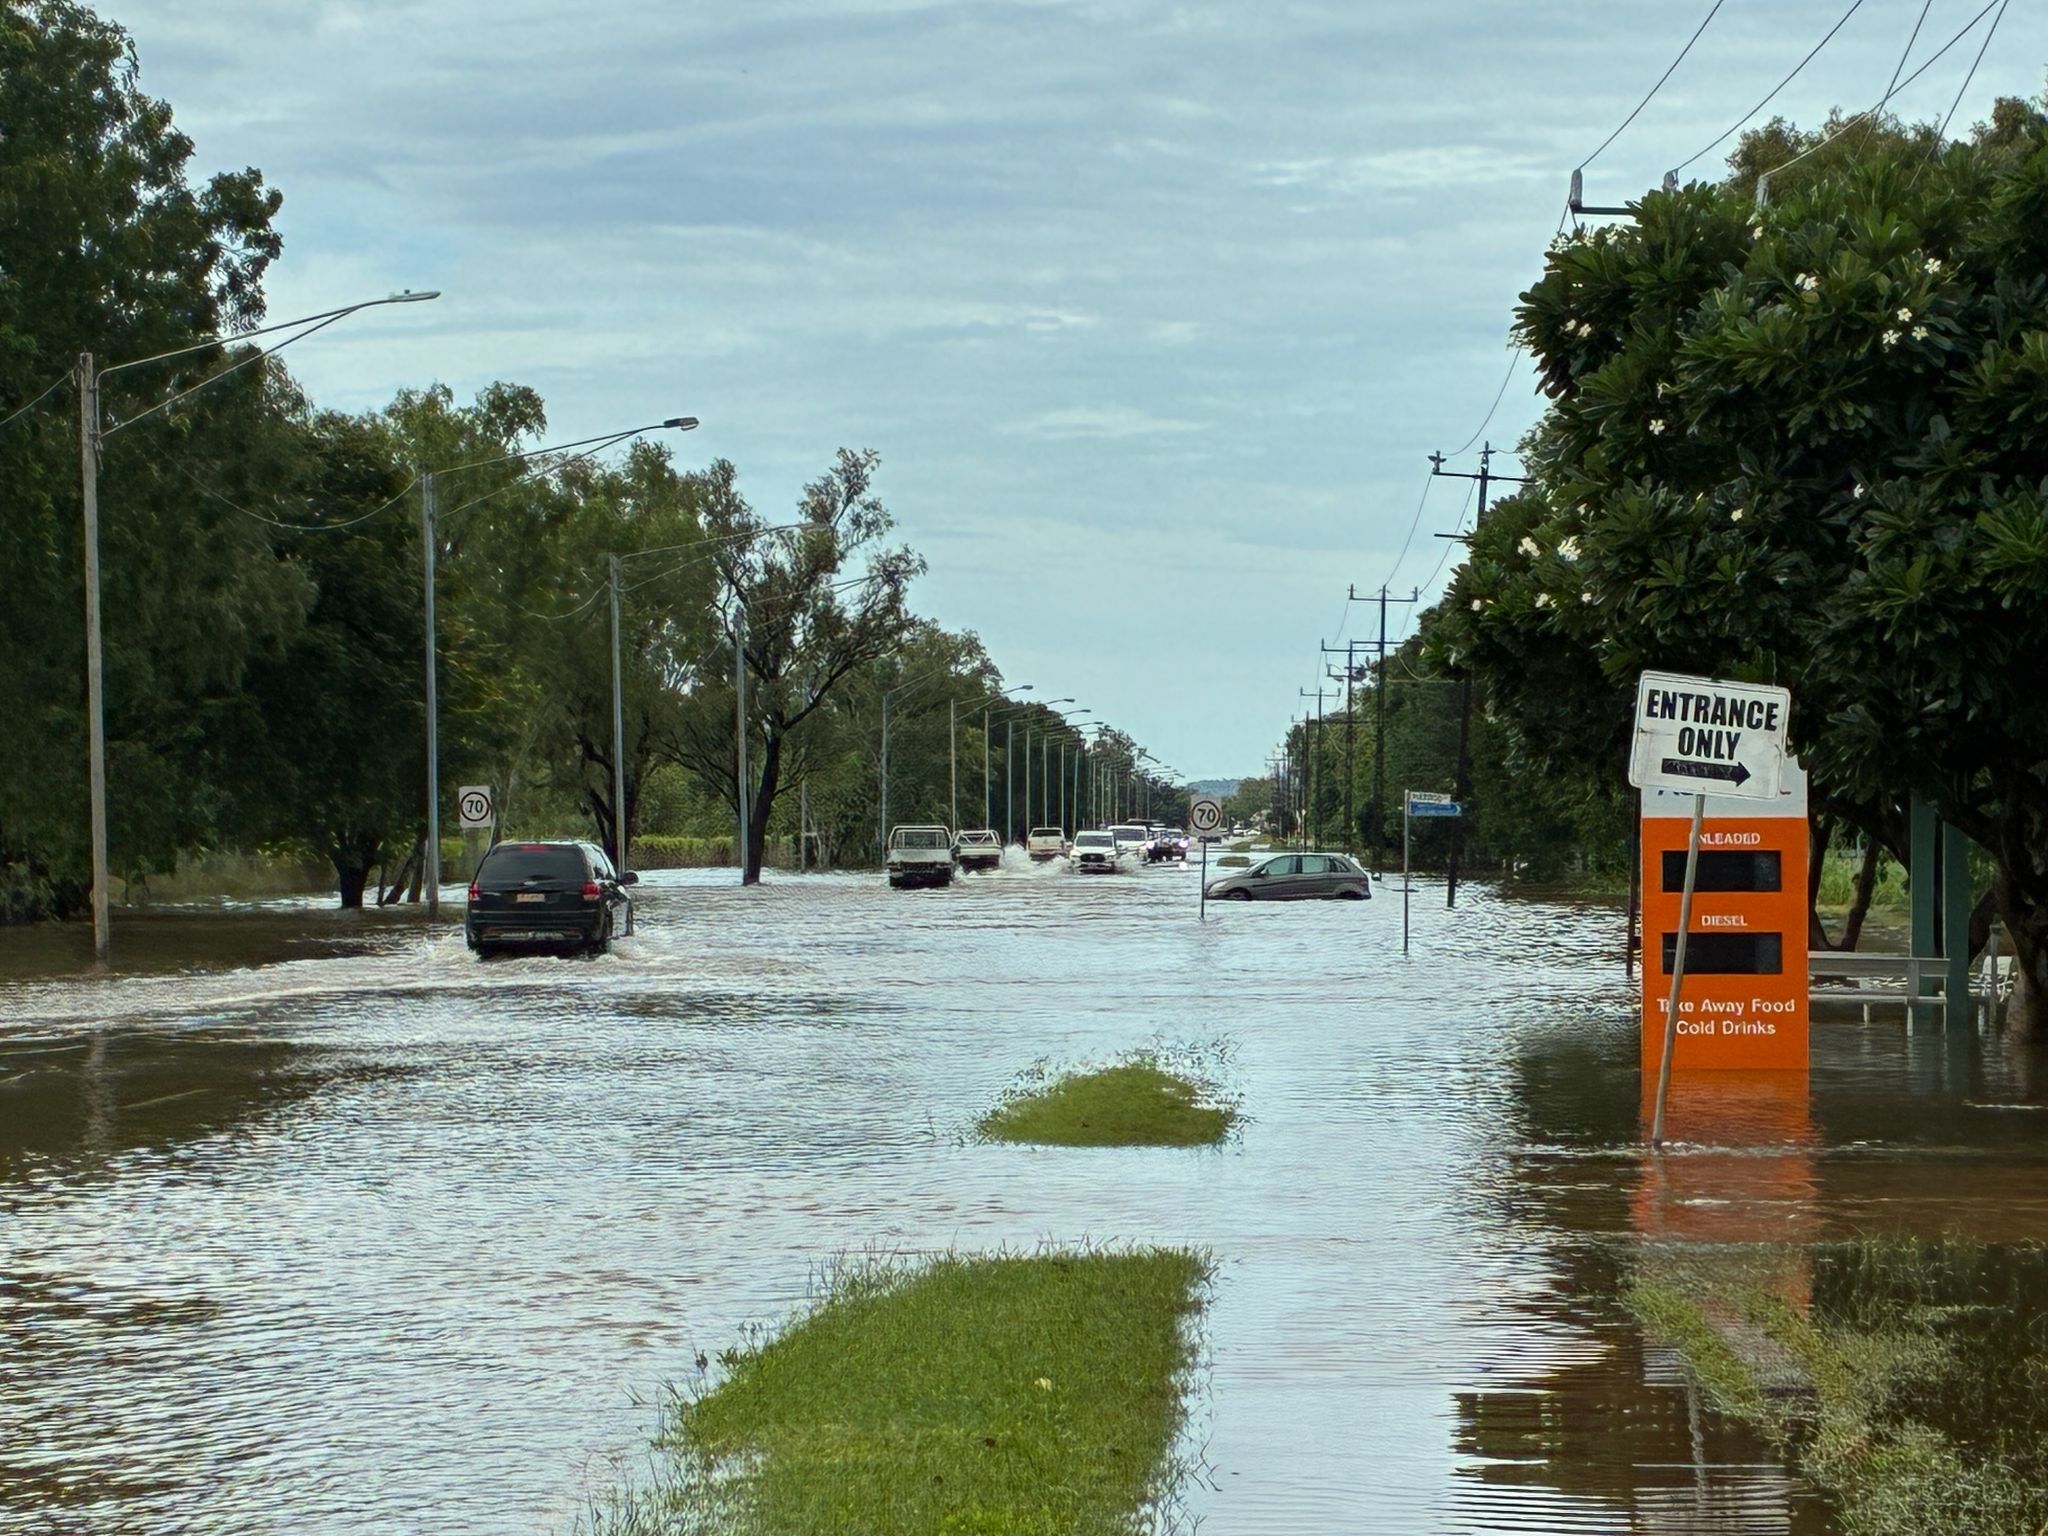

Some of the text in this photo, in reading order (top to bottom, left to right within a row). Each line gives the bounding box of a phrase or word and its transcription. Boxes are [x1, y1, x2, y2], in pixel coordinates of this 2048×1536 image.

[1646, 689, 1779, 731] ENTRANCE
[1678, 726, 1741, 760] ONLY
[467, 800, 483, 813] 70
[1197, 808, 1215, 823] 70
[1696, 832, 1761, 845] NLEADED
[1701, 914, 1748, 927] DIESEL
[1700, 998, 1744, 1015] Away
[1752, 998, 1795, 1012] Food
[1676, 1020, 1776, 1034] Cold Drinks
